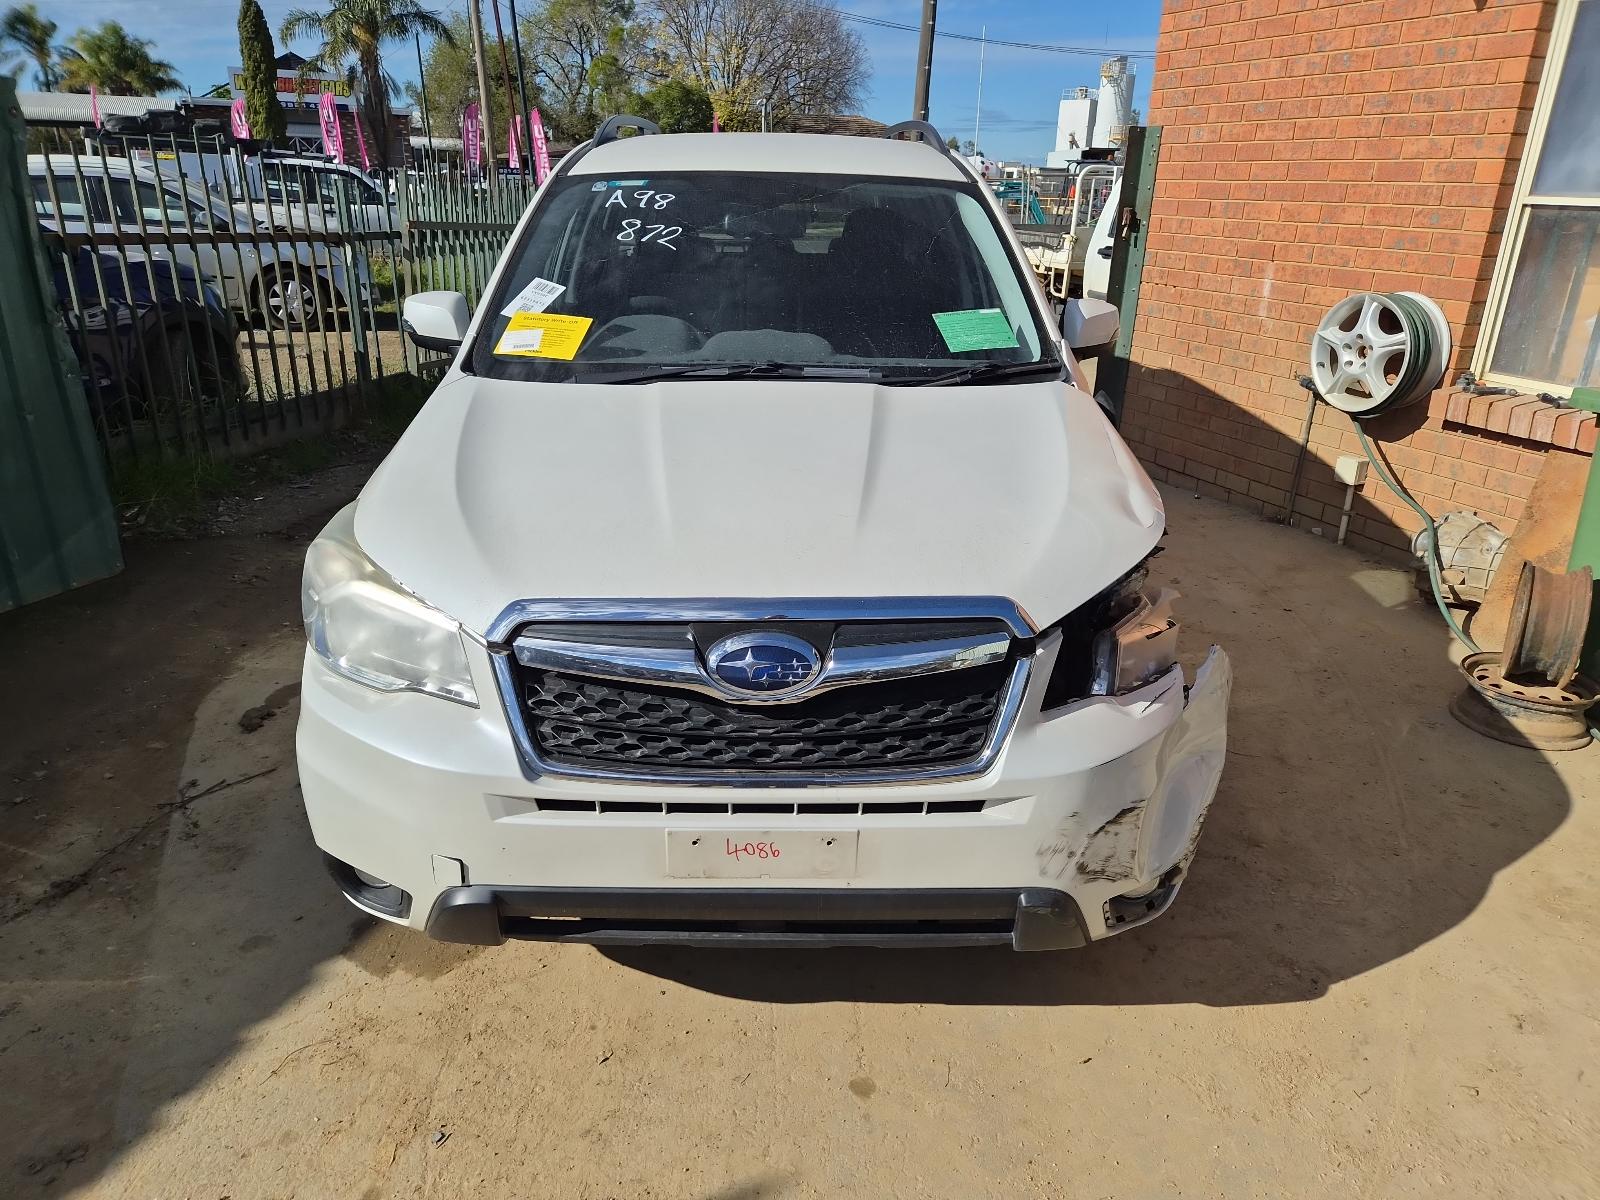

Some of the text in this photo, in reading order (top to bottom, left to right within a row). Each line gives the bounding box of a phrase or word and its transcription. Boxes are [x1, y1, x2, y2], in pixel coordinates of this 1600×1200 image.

[320, 80, 351, 97] CARS
[616, 218, 683, 251] 872
[725, 838, 781, 862] 4086
